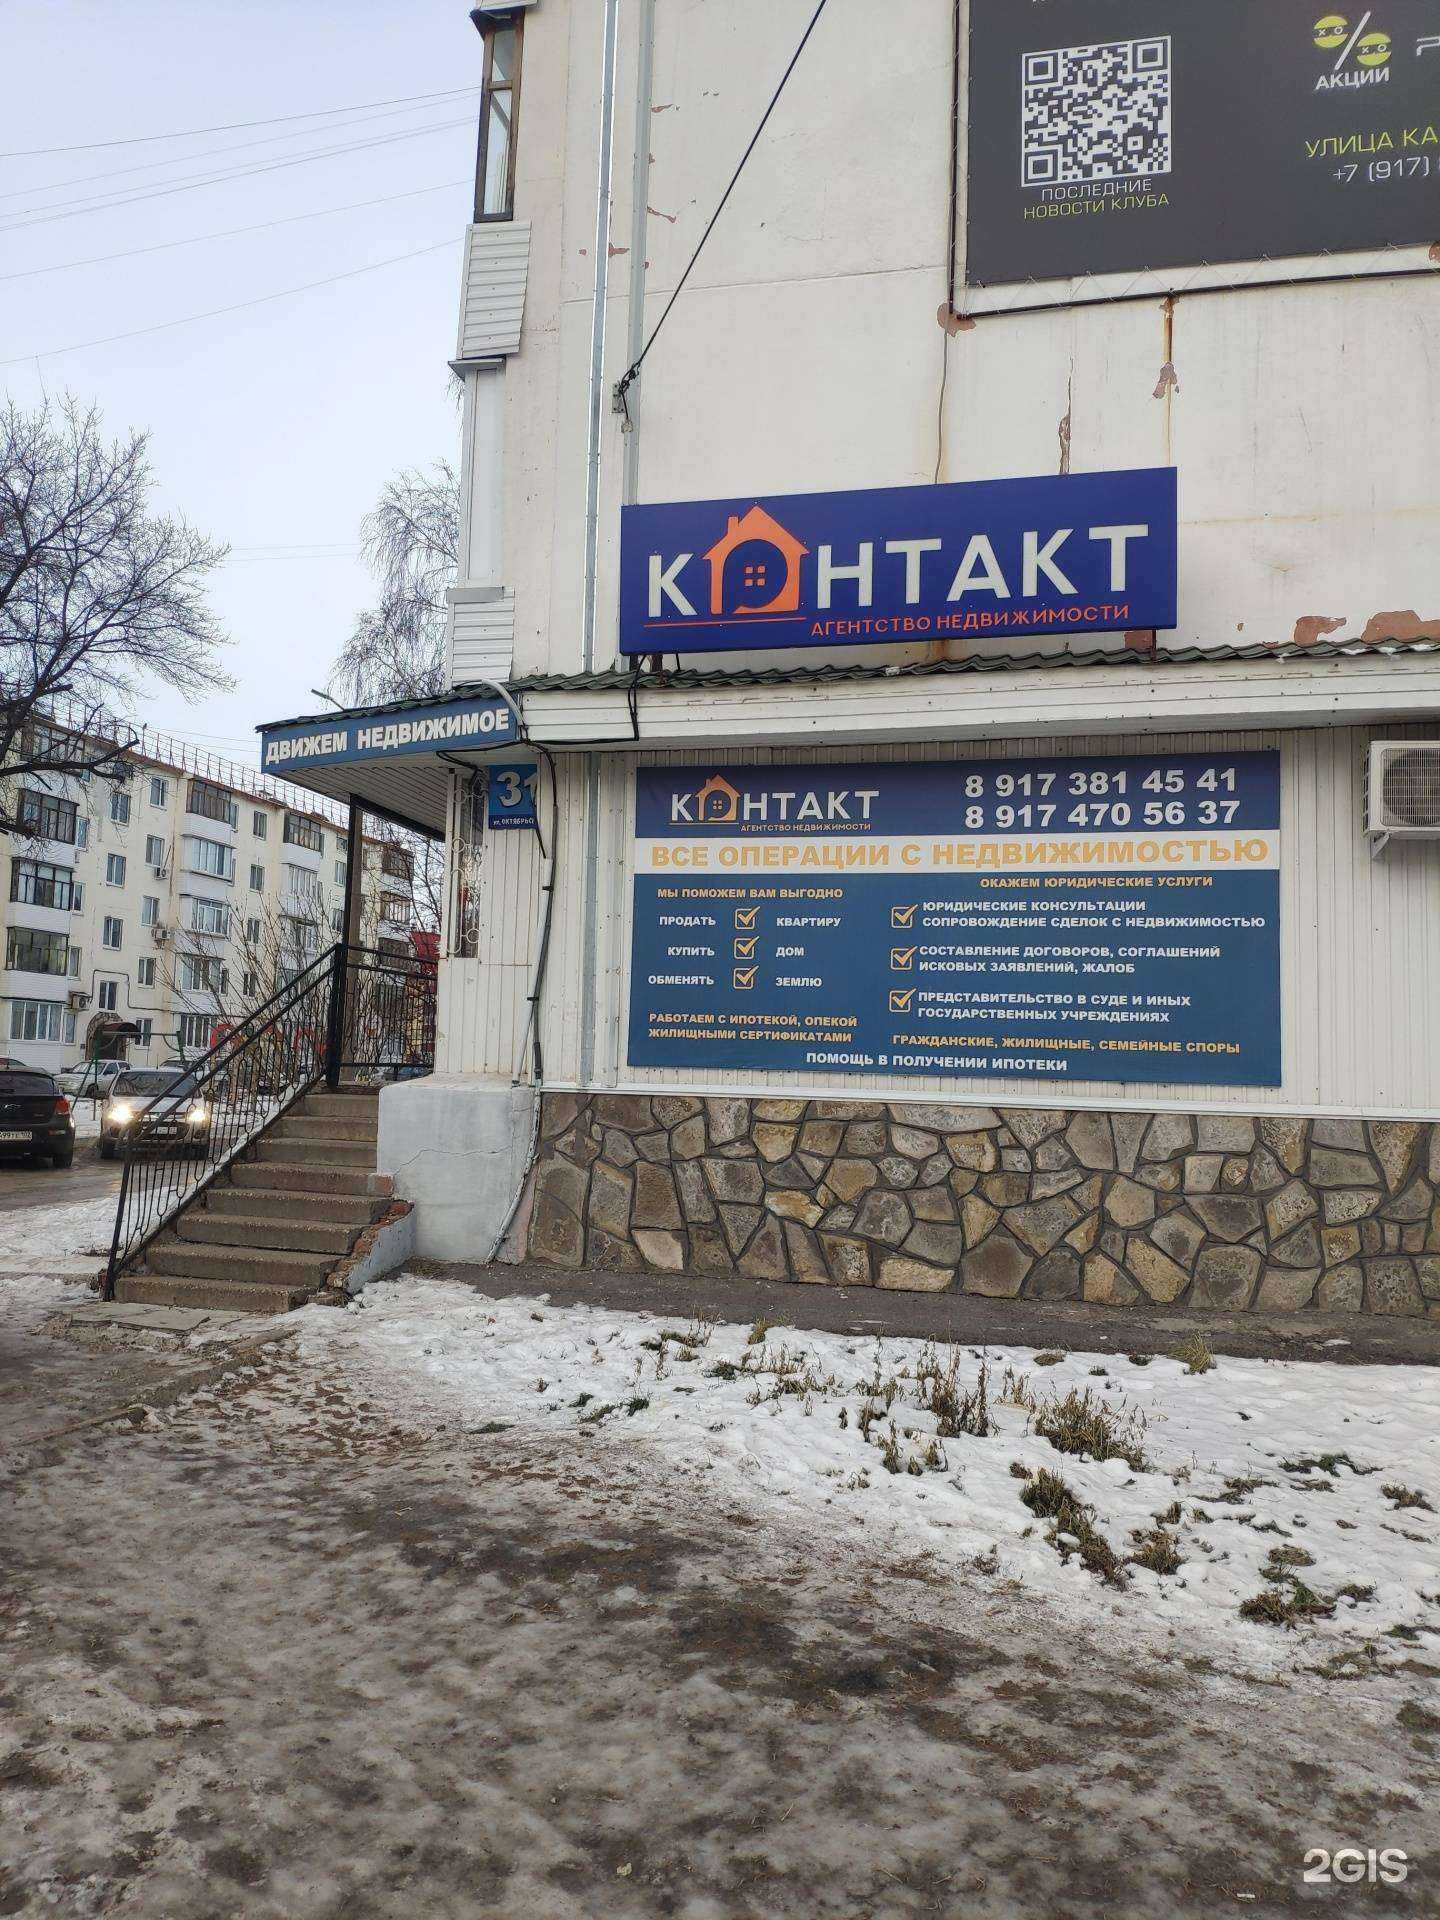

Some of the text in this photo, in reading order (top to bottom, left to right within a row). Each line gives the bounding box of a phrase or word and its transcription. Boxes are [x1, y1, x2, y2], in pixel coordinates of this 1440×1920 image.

[1315, 67, 1390, 90] АКЦИИ
[1305, 131, 1394, 158] УЛИЦА
[1333, 156, 1429, 183] +7 (917)
[1042, 178, 1152, 201] ПОСЛЕДНИЕ
[1024, 193, 1169, 219] НОВОСТИ КЛУБА
[810, 605, 1130, 637] АГЕНТСТВО НЕДВИЖИМОСТИ
[266, 708, 509, 765] ДВИЖЕМ НЕДВИЖИМОЕ
[964, 768, 1236, 798] 8 917 381 45 41
[964, 800, 1240, 829] 8 917 470 56 37
[741, 822, 871, 832] АГЕНТСТВО НЕДВИЖИМОСТИ
[652, 838, 1268, 869] ВСЕ ОПЕРАЦИИ С НЕДВИЖИМОСТЬЮ
[980, 876, 1213, 889] ОКАЖЕМ ЮРИДИЧЕСКИЕ УСЛУГИ
[657, 888, 843, 900] МЫ ПОМОЖЕМ ВАМ ВЫГОДНО
[922, 901, 1146, 912] ЮРИДИЧЕСКИЕ КОНСУЛЬТАЦИИ
[659, 916, 716, 927] ПРОДАТЬ
[776, 917, 841, 927] КВАРТИРУ
[922, 917, 1265, 928] СОПРОВОЖДЕНИЕ СДЕЛОК С НЕДВИЖИМОСТЬЮ
[667, 946, 715, 957] КУПИТЬ
[776, 947, 804, 958] ДОМ
[919, 945, 1220, 959] СОСТАВЛЕНИЕ ДОГОВОРОВ, СОГЛАШЕНИЙ
[919, 961, 1135, 974] ИСКОВЫХ ЗАЯВЛЕНИЙ, ЖАЛОБ
[648, 975, 715, 985] ОБМЕНЯТЬ
[775, 977, 822, 987] ЗЕМЛЮ
[918, 992, 1191, 1007] ПРЕДСТАВИТЕЛЬСТВО В СУДЕ И ИНЫХ
[649, 1013, 858, 1027] РАБОТАЕМ С ИПОТЕКОЙ, ОПЕКОЙ
[918, 1007, 1170, 1023] ГОСУДАРСТВЕННЫХ УЧРЕЖДЕНИЯХ
[648, 1029, 852, 1043] ЖИЛИЩНЫМИ СЕРТИФИКАТАМИ
[892, 1034, 1240, 1054] ГРАЖДАНСКИЕ, ЖИЛИЩНЫЕ, СЕМЕЙНЫЕ СПОРЫ
[806, 1053, 1067, 1071] ПОМОЩЬ В ПОЛУЧЕНИИ ИПОТЕКИ
